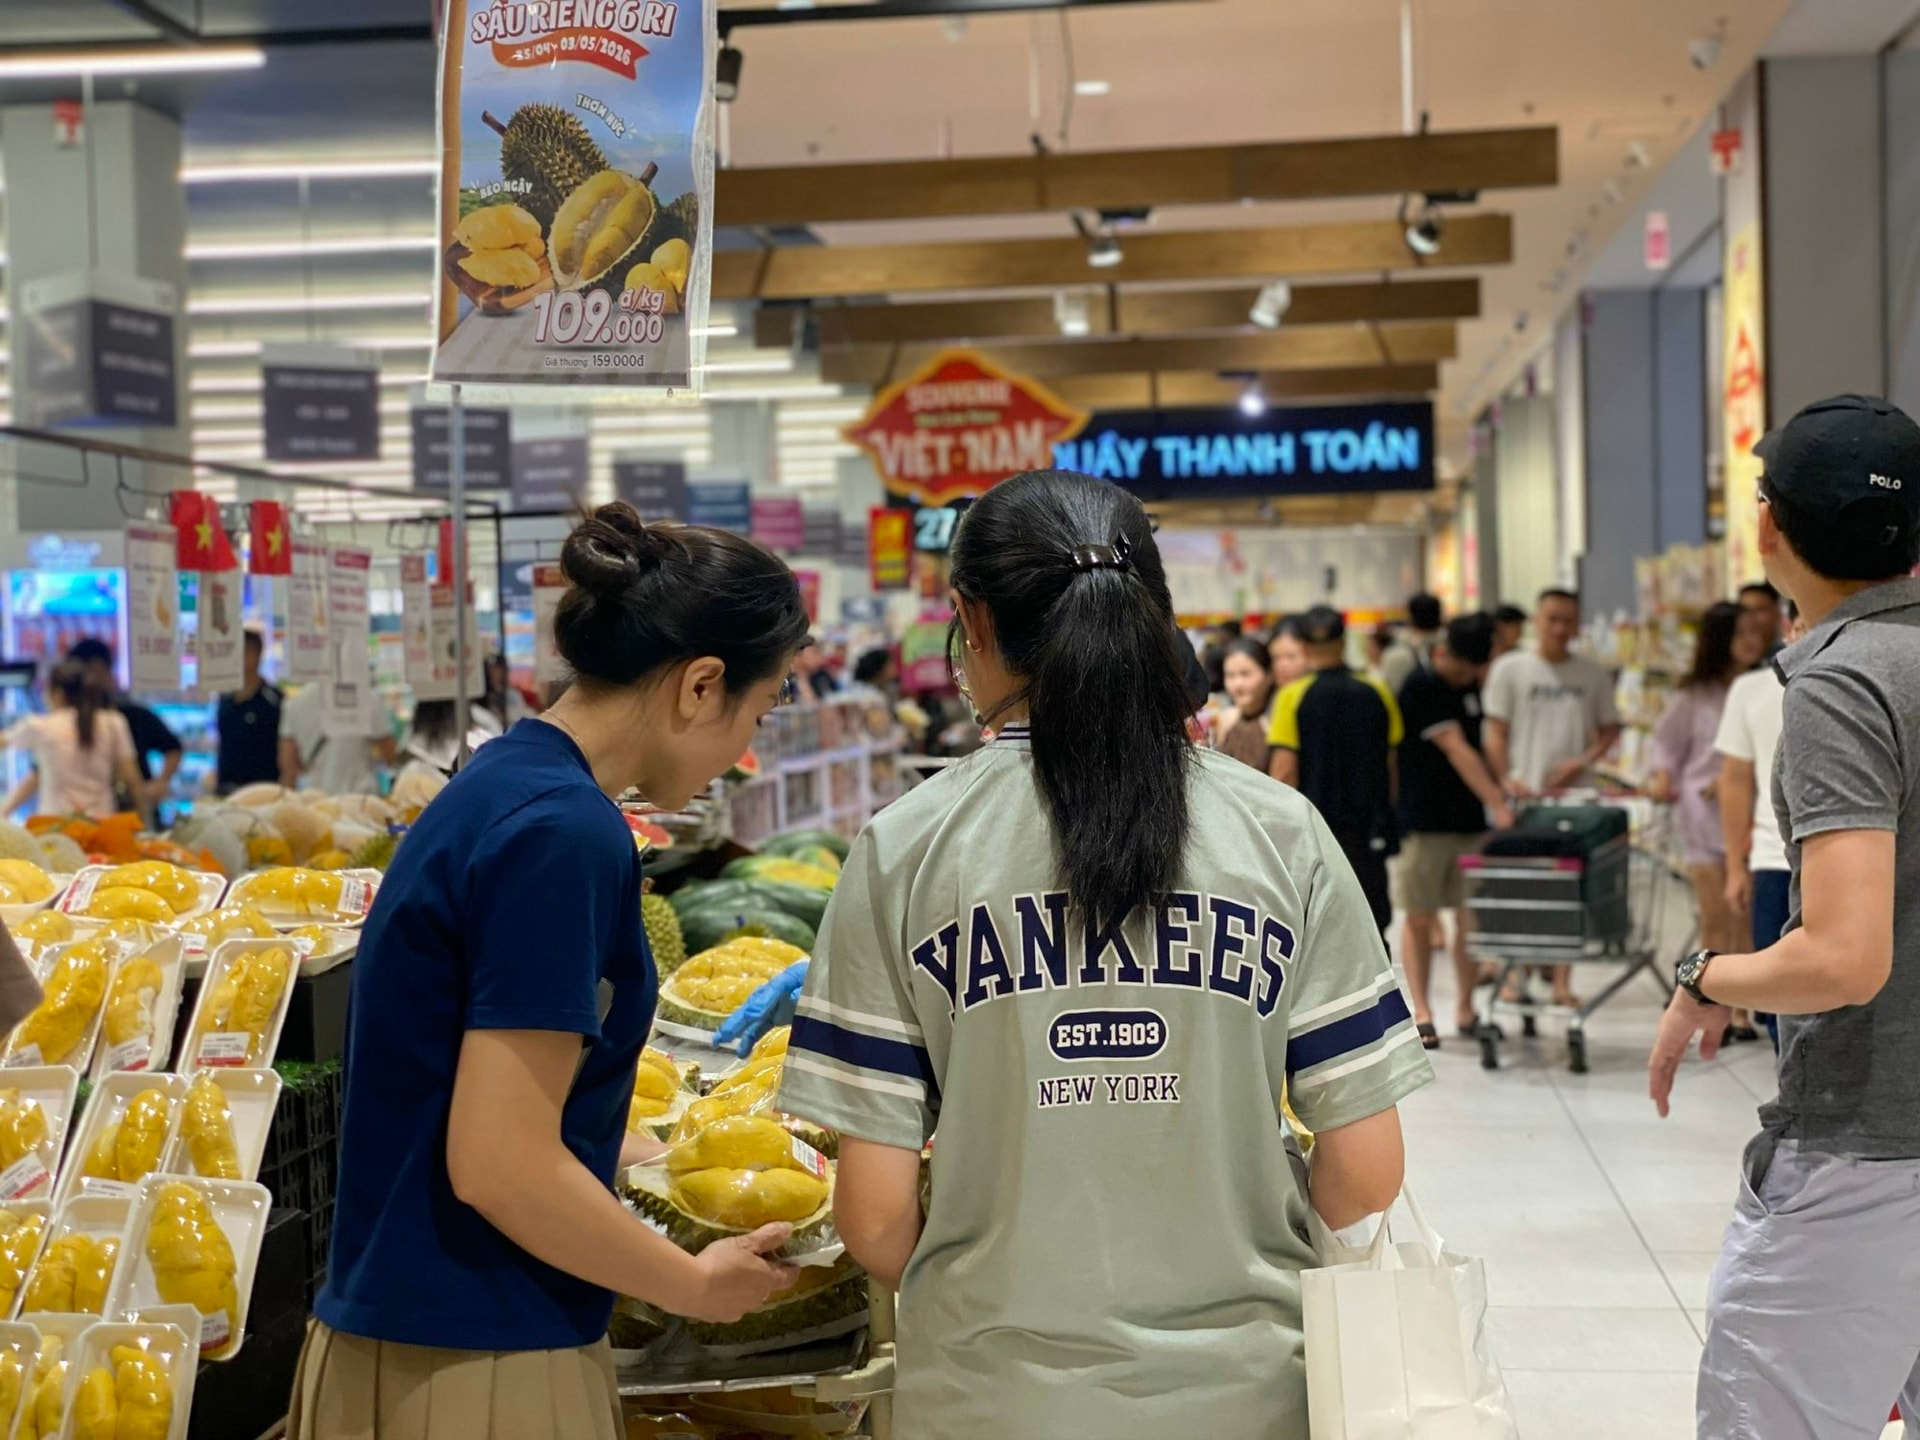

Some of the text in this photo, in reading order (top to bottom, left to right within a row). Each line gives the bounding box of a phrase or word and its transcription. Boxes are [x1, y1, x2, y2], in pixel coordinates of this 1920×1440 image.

[617, 0, 640, 32] 6
[641, 1, 678, 37] RI
[560, 34, 632, 66] 03/05/2026
[592, 354, 644, 367] 159.000đ
[1153, 430, 1295, 478] THANH
[1302, 420, 1421, 474] TOÁN
[1869, 473, 1902, 490] POLO
[914, 507, 958, 549] 27
[910, 889, 1297, 1021] YANKEES
[1055, 1021, 1161, 1049] EST.1903
[1038, 1073, 1180, 1109] NEW YORK
